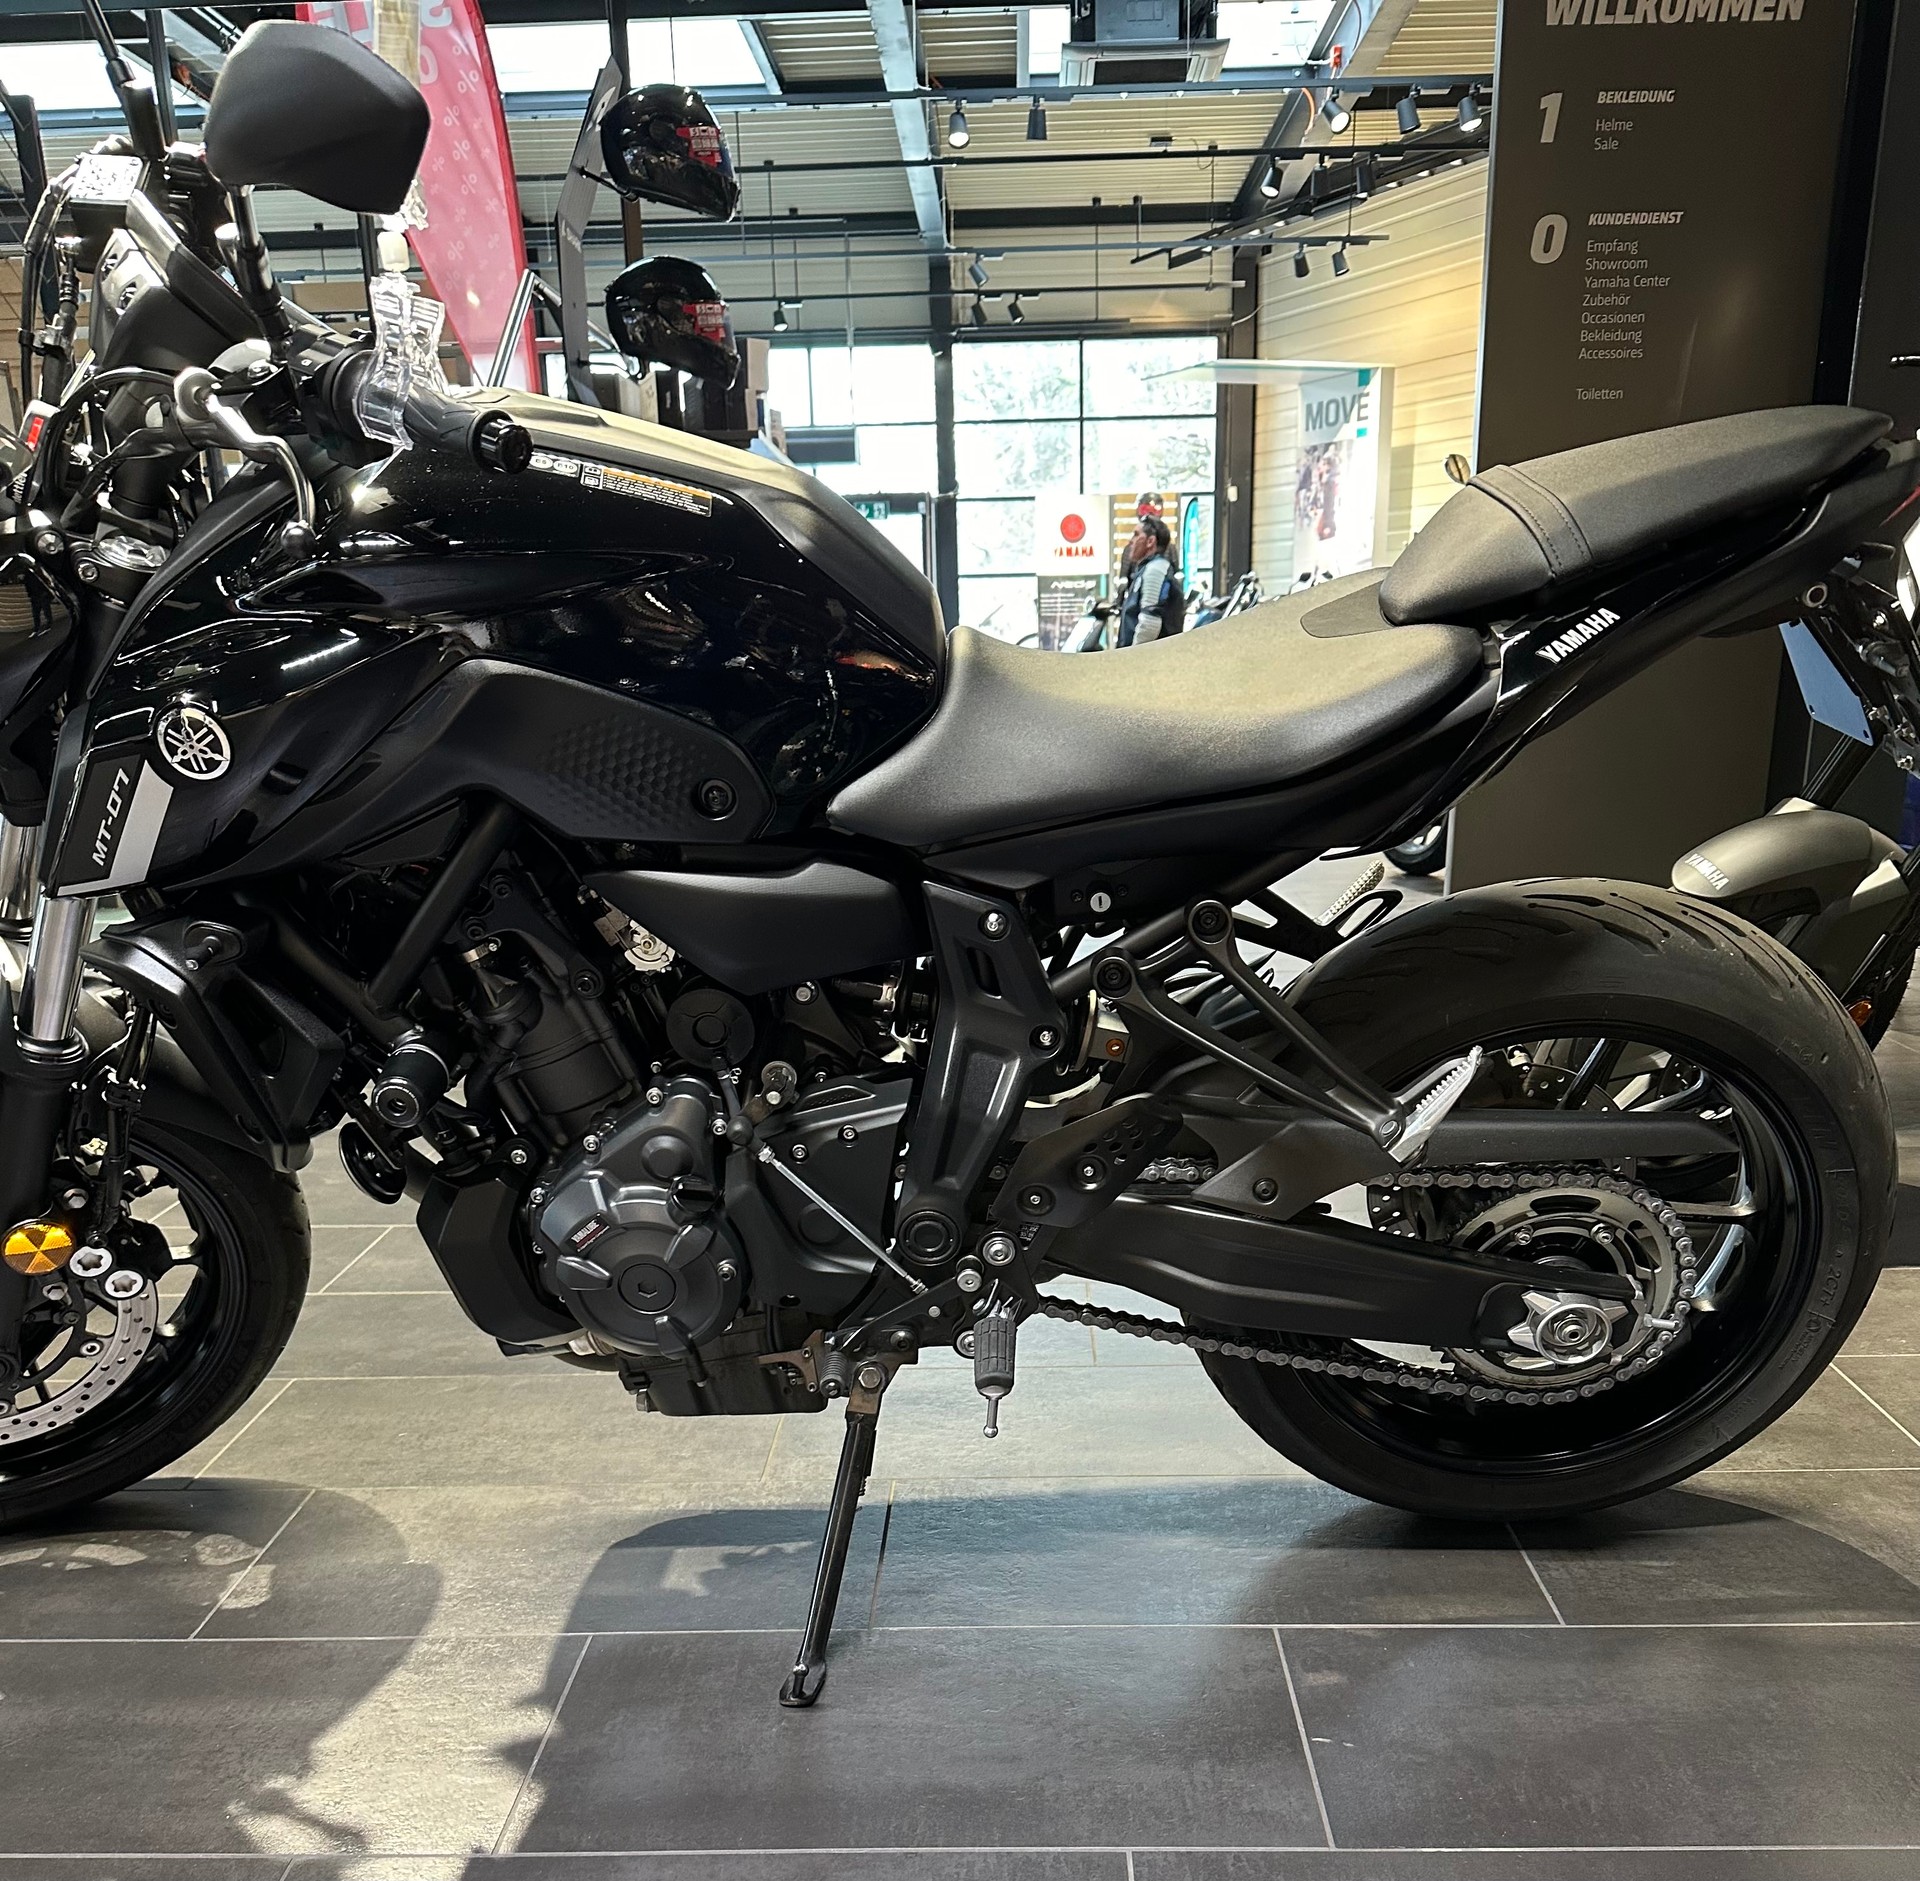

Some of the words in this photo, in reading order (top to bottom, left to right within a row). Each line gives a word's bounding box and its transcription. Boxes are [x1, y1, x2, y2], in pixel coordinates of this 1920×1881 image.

[1546, 0, 1804, 26] WILLKOMMEN
[1597, 89, 1676, 104] BEKLEIDUNG
[1540, 92, 1563, 144] 1
[1595, 118, 1634, 132] Helme
[1594, 136, 1619, 151] Sale
[1588, 211, 1684, 226] KUNDENDIENST
[1530, 213, 1568, 264] 0
[1586, 238, 1639, 255] Empfang
[1585, 258, 1648, 271] Showroom
[1584, 275, 1630, 288] Yamaha
[1633, 275, 1671, 287] Center
[1582, 293, 1631, 306] Zubehör
[1581, 311, 1645, 324] Occasionen
[1580, 329, 1643, 344] Bekleidung
[1578, 346, 1644, 360] Accessoires
[1576, 388, 1624, 400] Toiletten
[1304, 391, 1371, 433] MOVE
[1054, 545, 1095, 557] YAMAHA
[1535, 607, 1621, 665] YAMAHA
[91, 767, 131, 867] MT-07
[1684, 853, 1730, 891] YAMAHA
